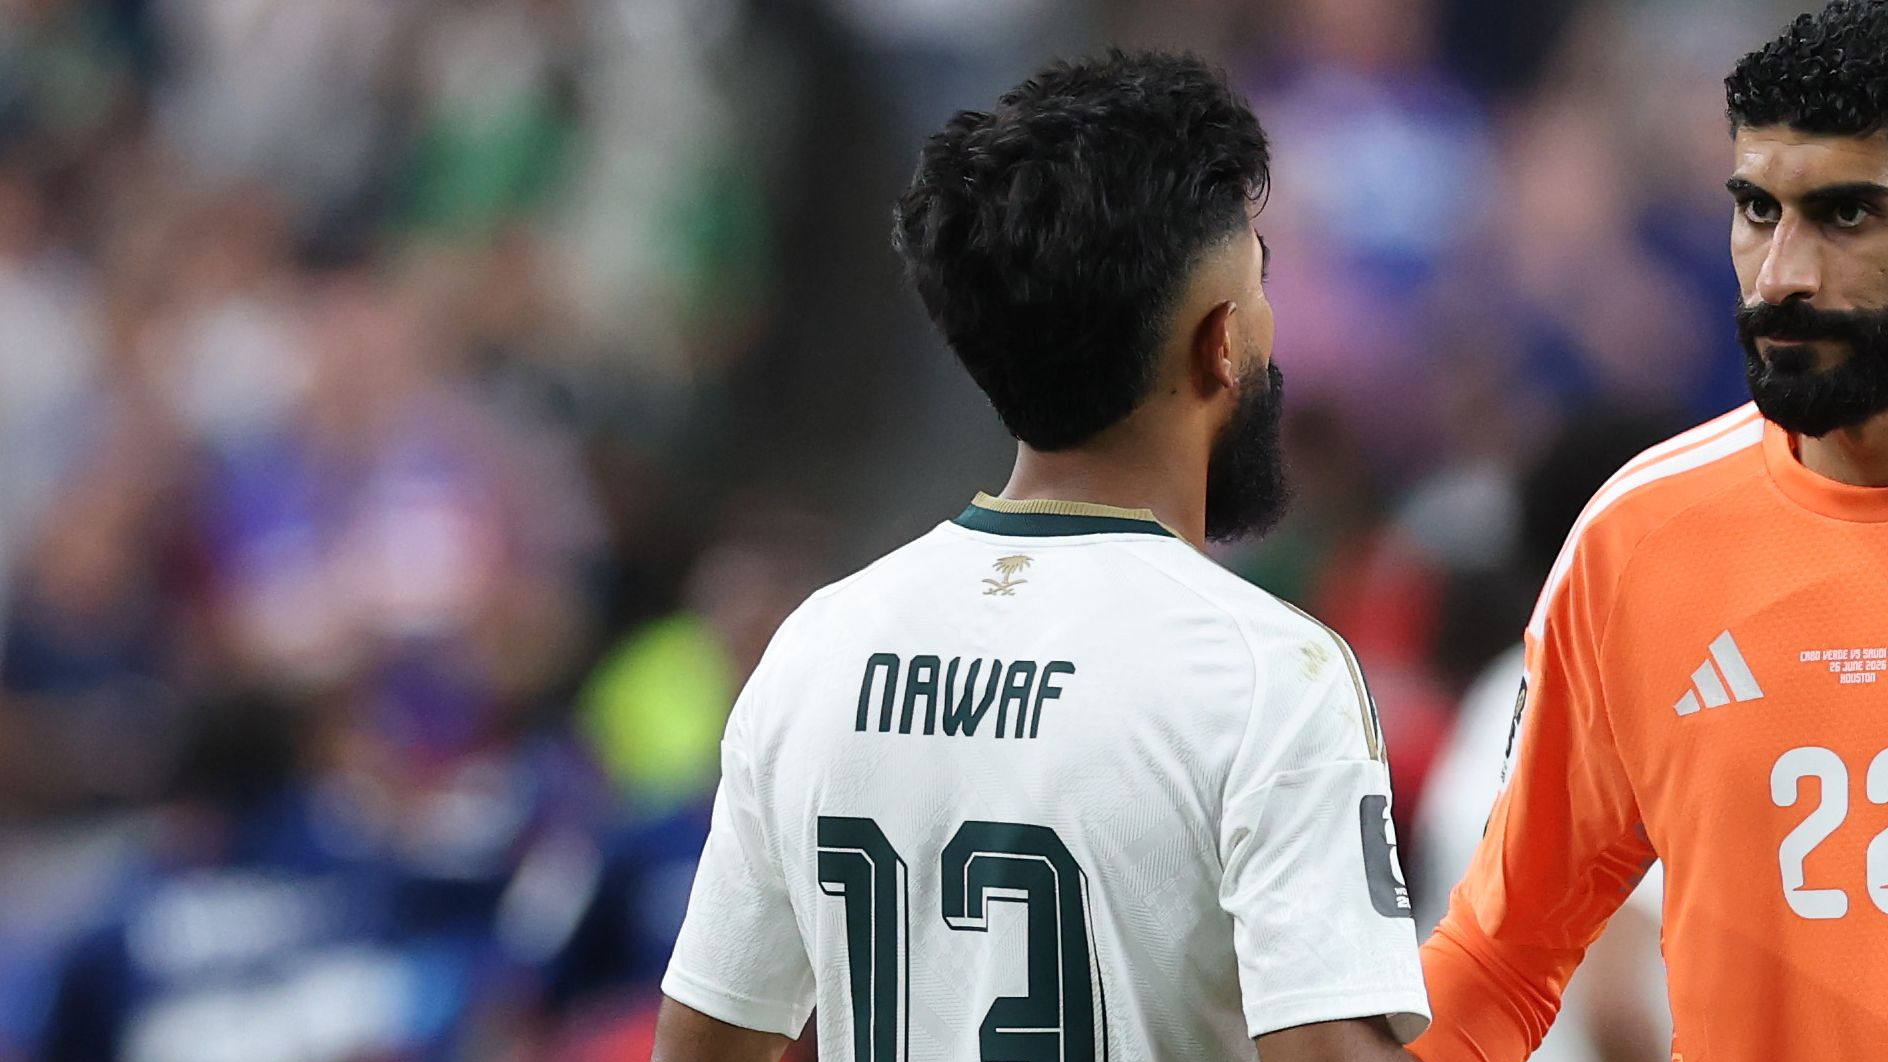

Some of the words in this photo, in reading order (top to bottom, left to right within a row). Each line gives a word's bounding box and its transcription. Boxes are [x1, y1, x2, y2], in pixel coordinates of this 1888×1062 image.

[1823, 648, 1848, 661] VERDE
[1850, 648, 1861, 659] VS
[1863, 647, 1887, 659] SAUDI
[1829, 661, 1841, 672] 26
[1842, 660, 1864, 672] JUNE
[1865, 659, 1888, 671] 2026
[1840, 672, 1877, 684] HOUSTON
[855, 653, 1077, 739] NAWAF
